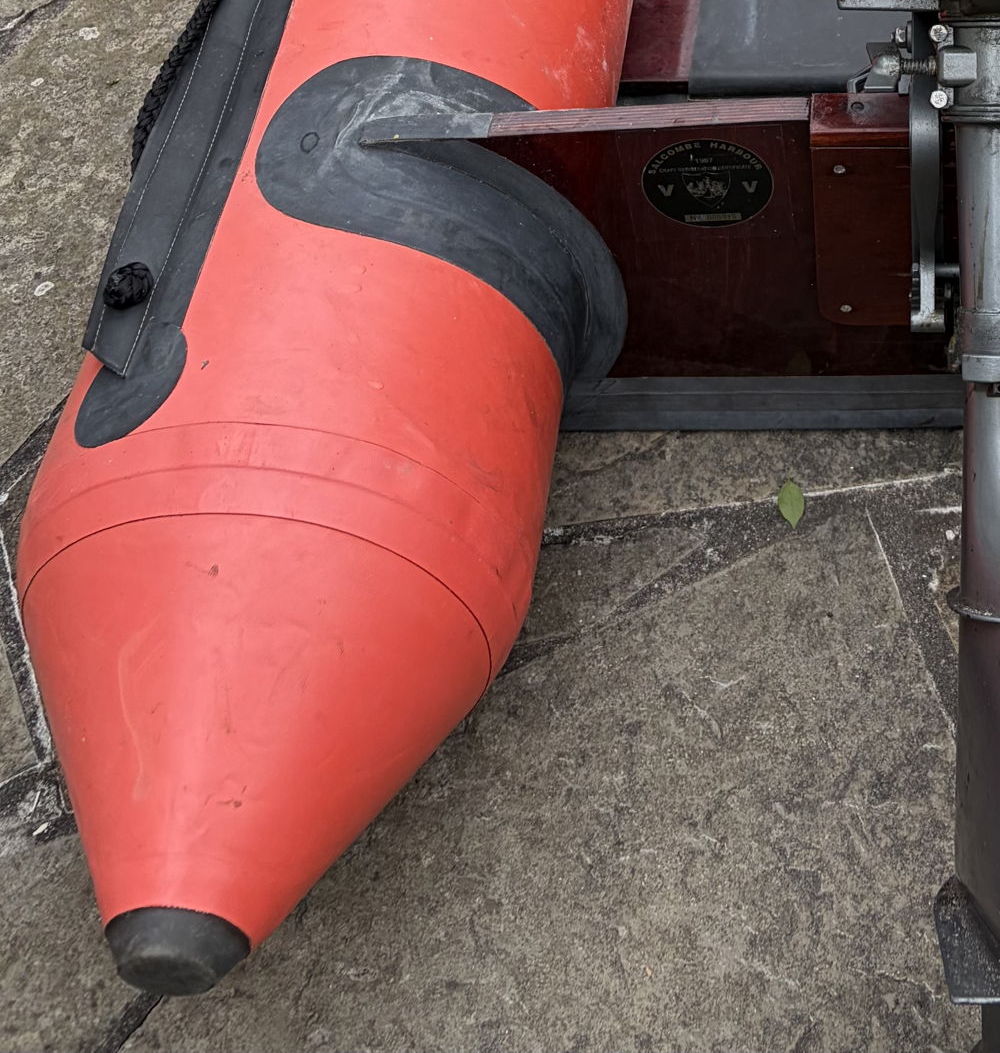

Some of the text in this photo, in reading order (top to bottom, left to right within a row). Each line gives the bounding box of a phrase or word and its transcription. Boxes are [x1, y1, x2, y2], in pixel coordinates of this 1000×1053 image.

[648, 141, 763, 175] SALCOMBE HARBOUR
[657, 181, 758, 197] V V
